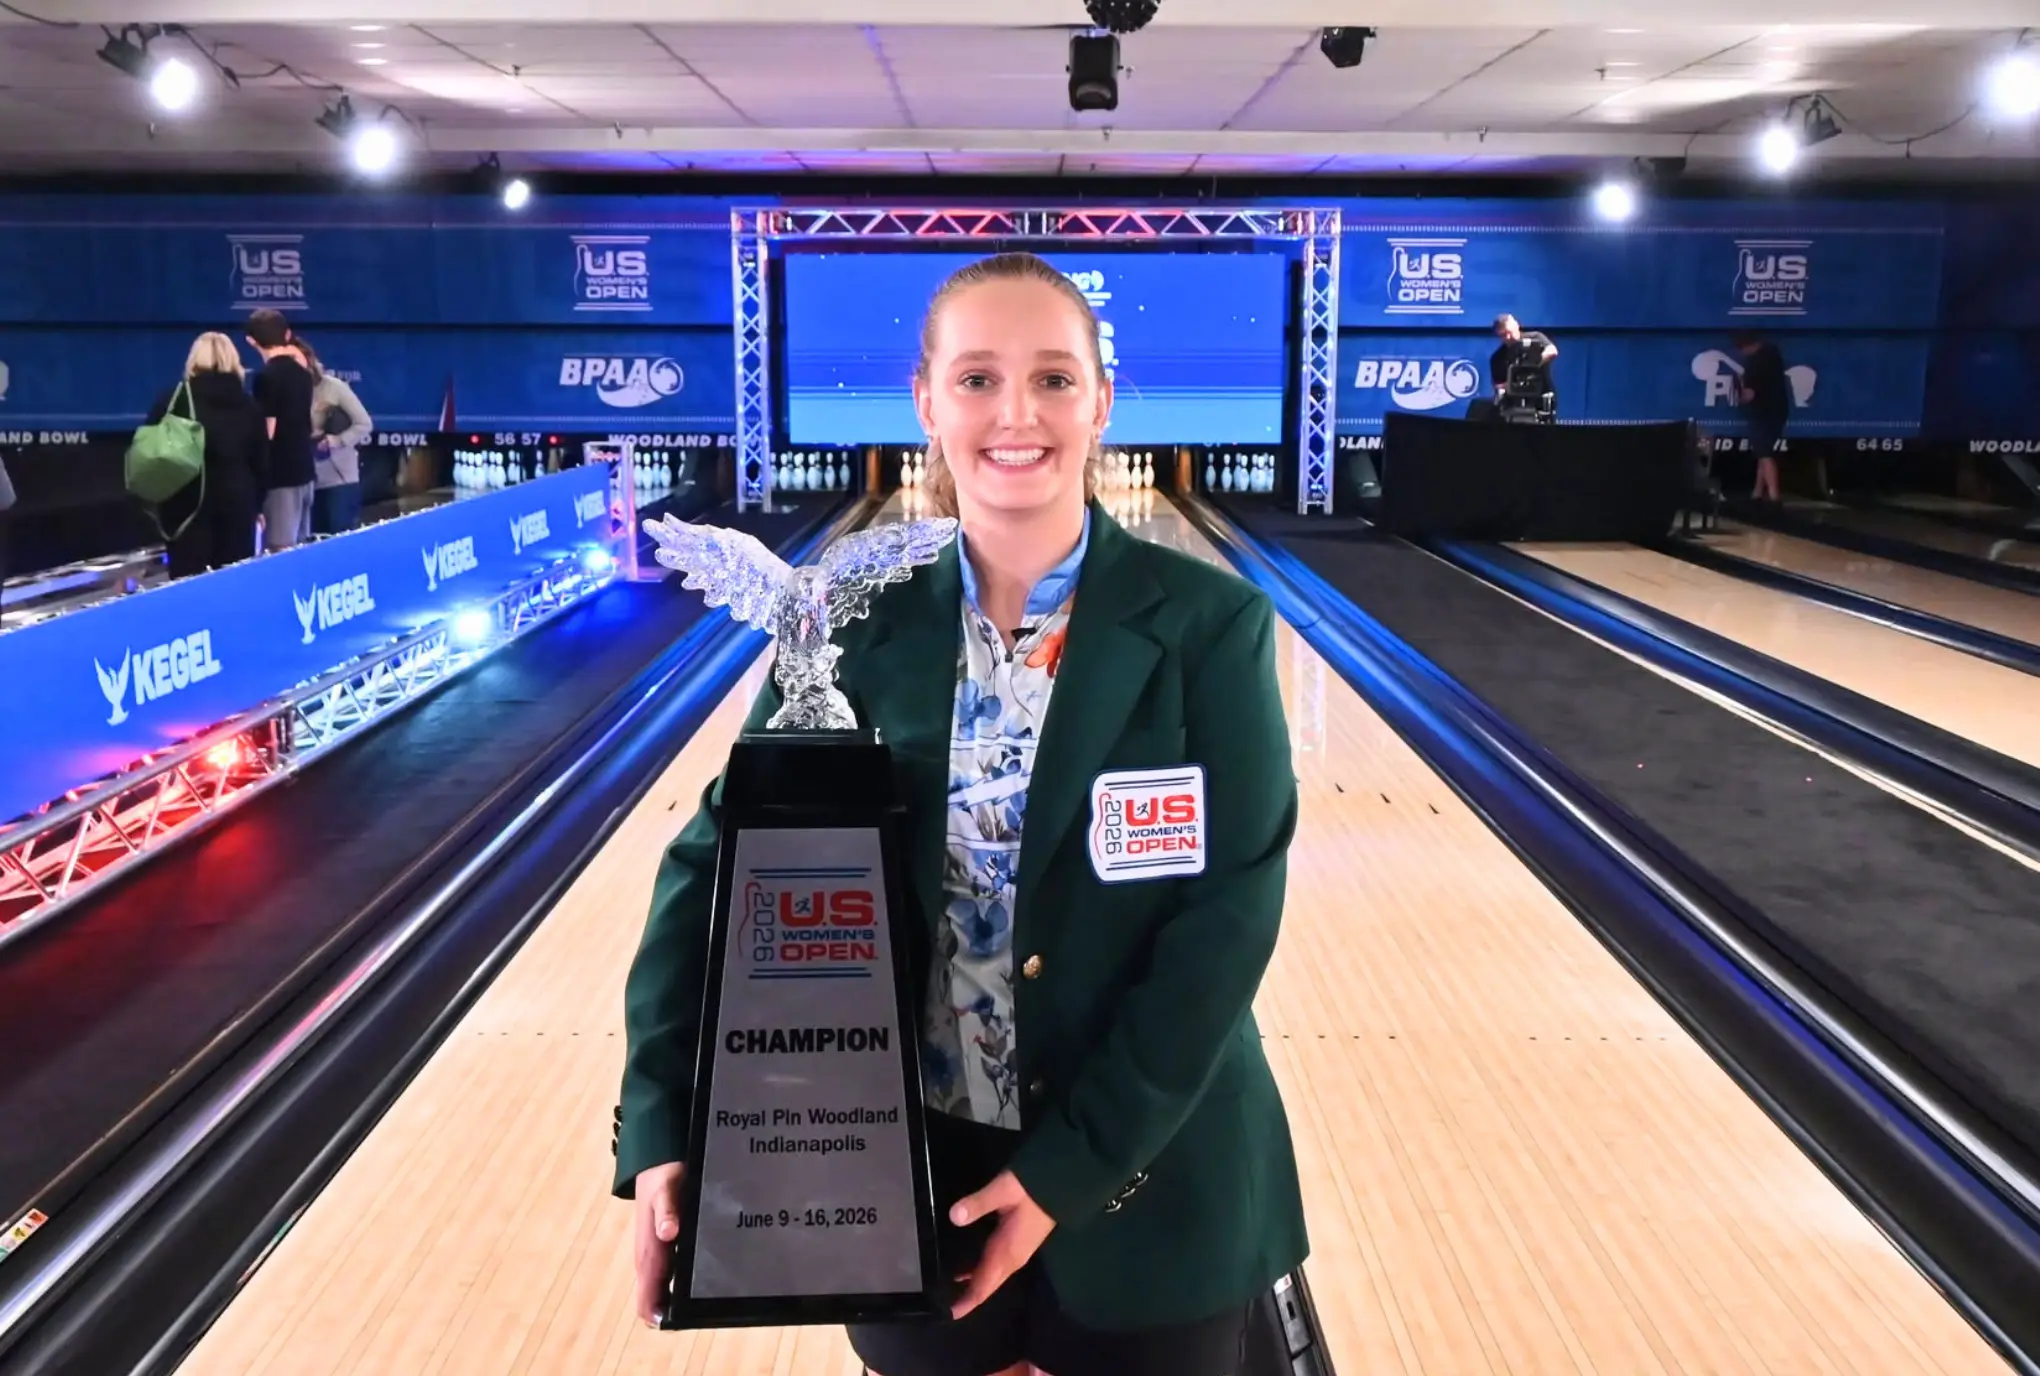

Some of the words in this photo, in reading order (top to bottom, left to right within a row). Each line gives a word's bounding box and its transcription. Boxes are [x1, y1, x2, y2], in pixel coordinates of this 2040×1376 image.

[242, 285, 305, 298] OPEN
[586, 286, 648, 299] OPEN
[1398, 289, 1461, 302] OPEN
[1743, 291, 1803, 303] OPEN
[559, 358, 648, 386] BPAA
[1354, 361, 1444, 388] BPAA
[39, 431, 89, 444] BOWL
[378, 433, 428, 445] BOWL
[494, 433, 515, 445] 56
[521, 433, 541, 445] 57
[608, 434, 711, 447] WOODLAND
[1857, 438, 1877, 451] 64
[1882, 438, 1903, 451] 65
[438, 536, 478, 581] KEGEL
[317, 573, 376, 630] KEGEL
[131, 629, 222, 705] KEGEL
[1125, 794, 1198, 827] U.S.
[1105, 800, 1122, 855] 2026
[1128, 825, 1197, 838] WOMEN'S
[1126, 836, 1197, 854] OPEN
[780, 890, 878, 927] U.S.
[753, 892, 775, 962] 2026
[782, 929, 875, 941] WOMEN'S
[780, 942, 876, 962] OPEN
[725, 1027, 889, 1054] CHAMPION
[716, 1110, 766, 1130] Royal
[773, 1109, 801, 1126] Pin
[808, 1107, 899, 1125] Woodland
[750, 1135, 866, 1155] Indianapolis
[737, 1210, 773, 1228] June
[778, 1210, 789, 1227] 9
[805, 1209, 830, 1228] 16,
[835, 1207, 878, 1225] 2026
